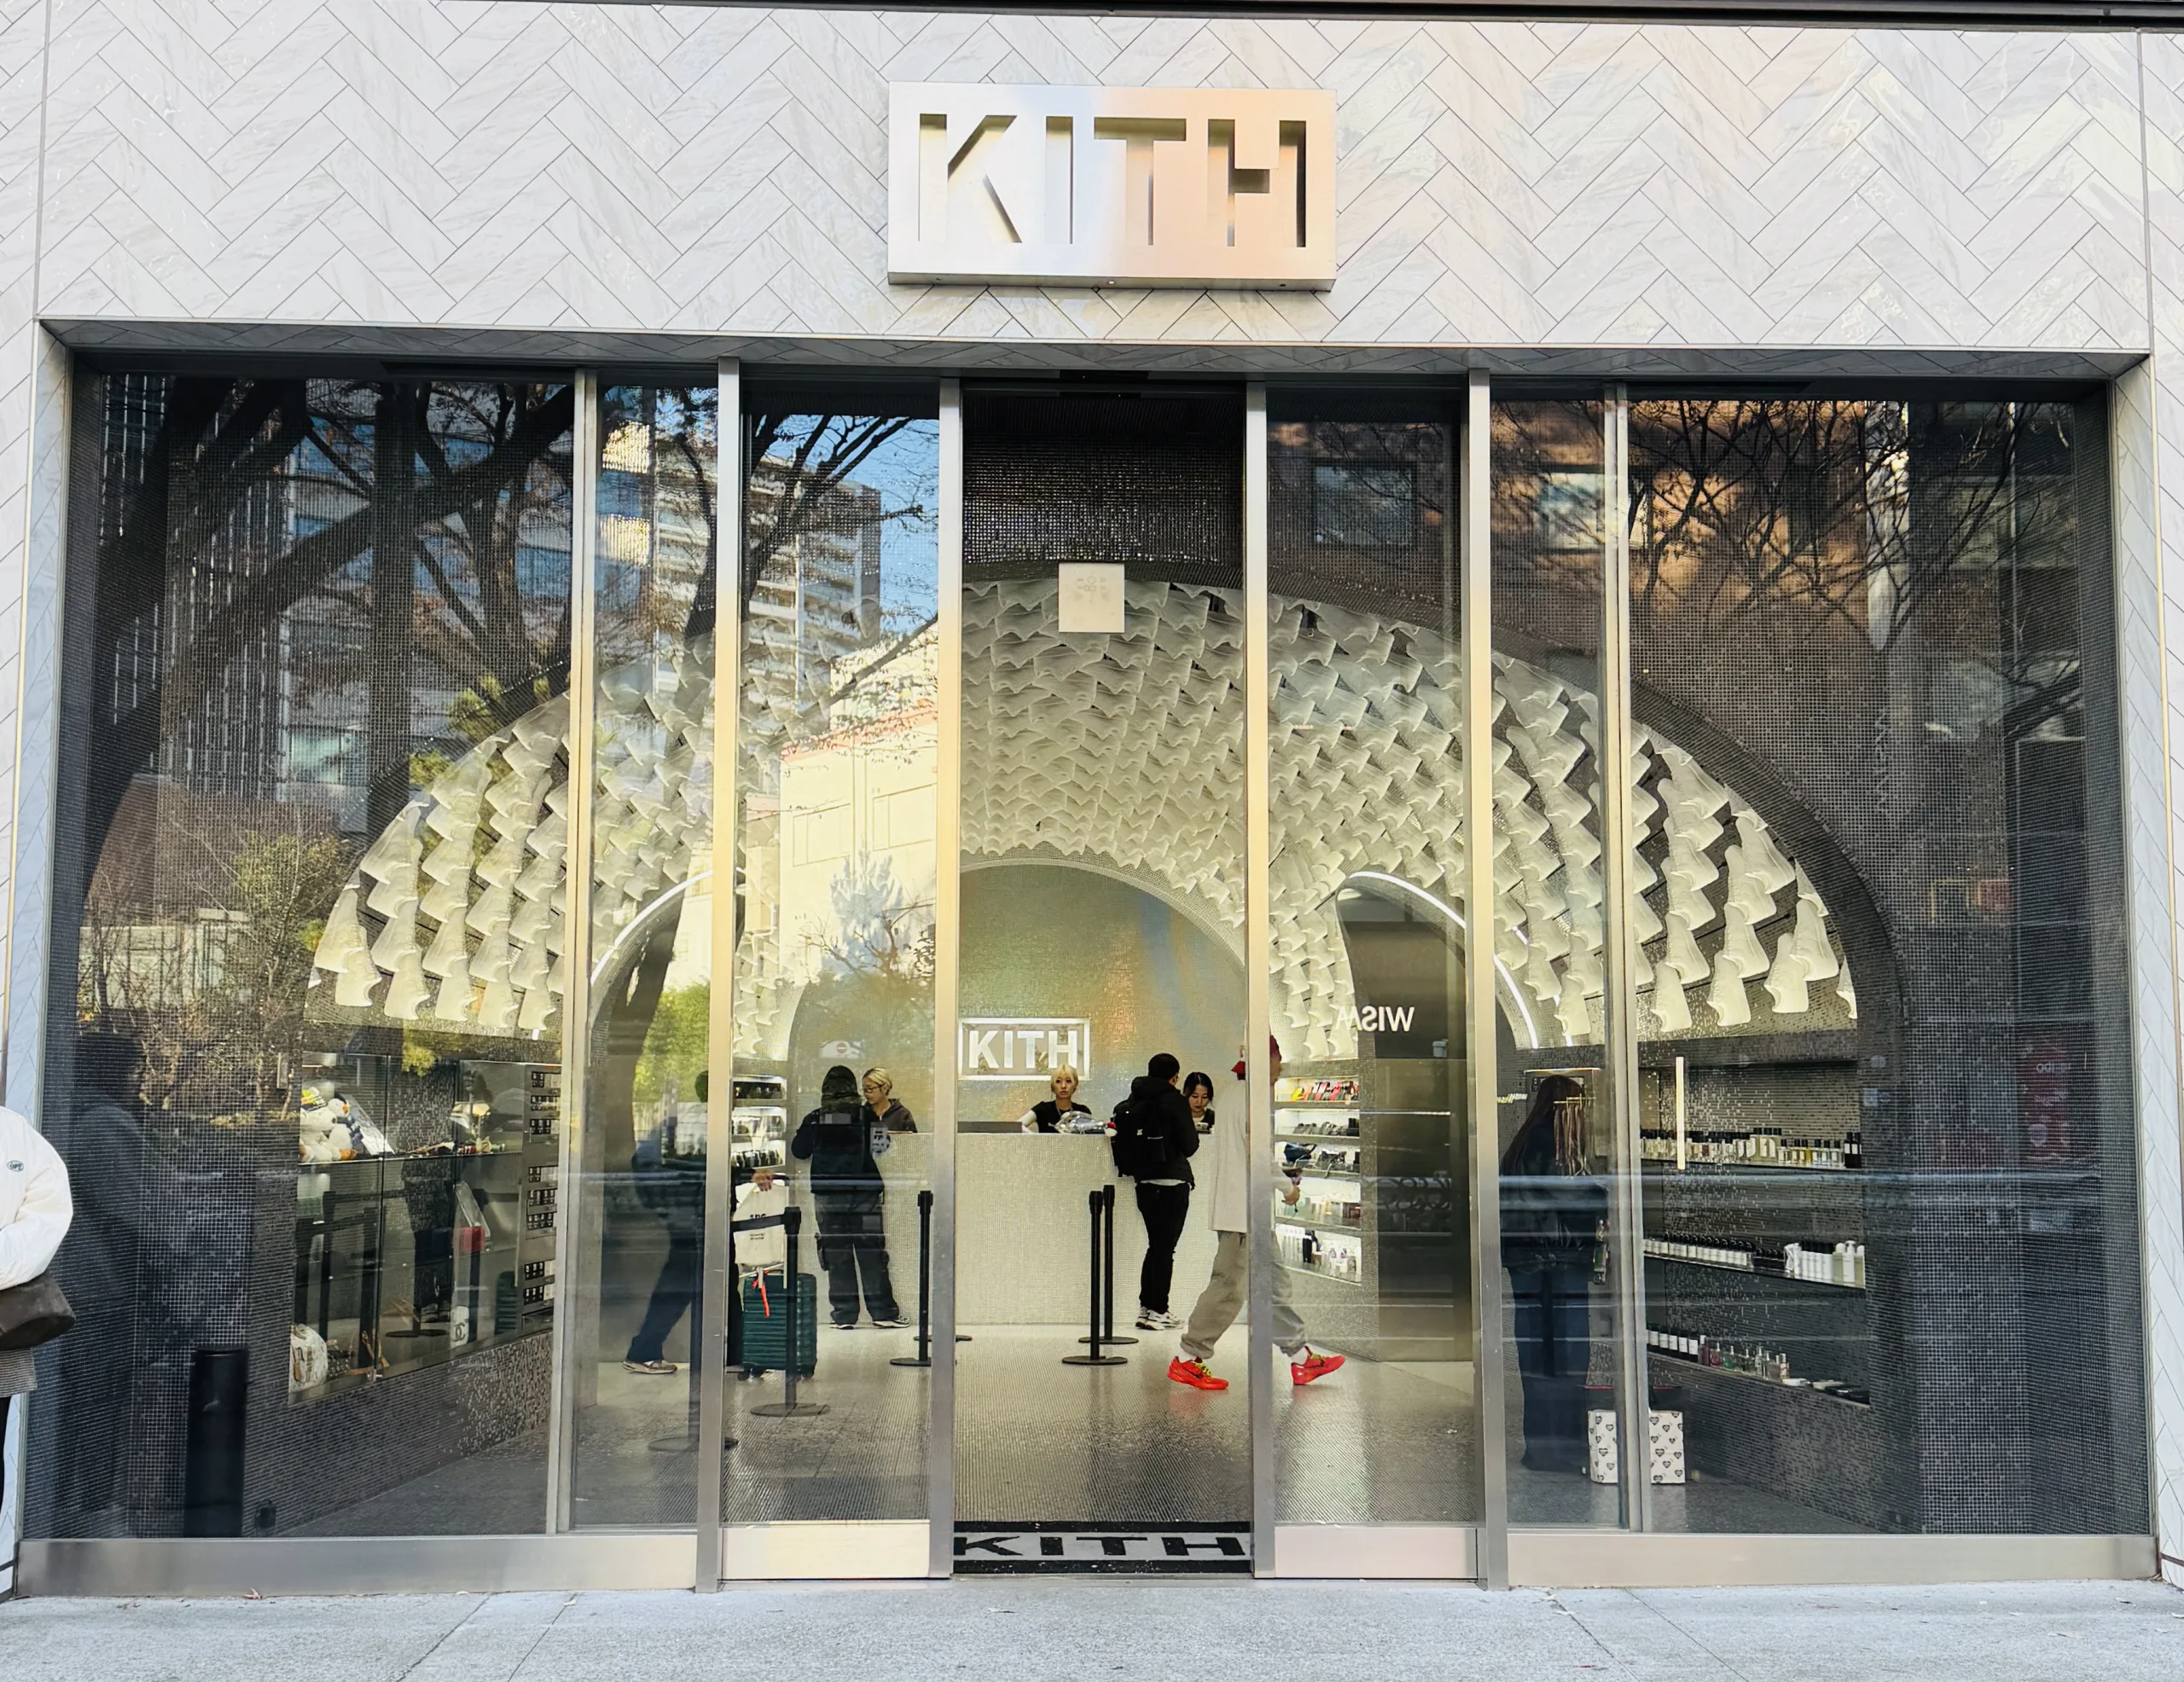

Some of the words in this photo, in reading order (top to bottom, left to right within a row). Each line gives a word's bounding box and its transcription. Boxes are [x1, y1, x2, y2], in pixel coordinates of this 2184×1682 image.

[918, 113, 1307, 248] KITH
[968, 1030, 1077, 1069] KITH
[953, 1534, 1246, 1557] KITH
